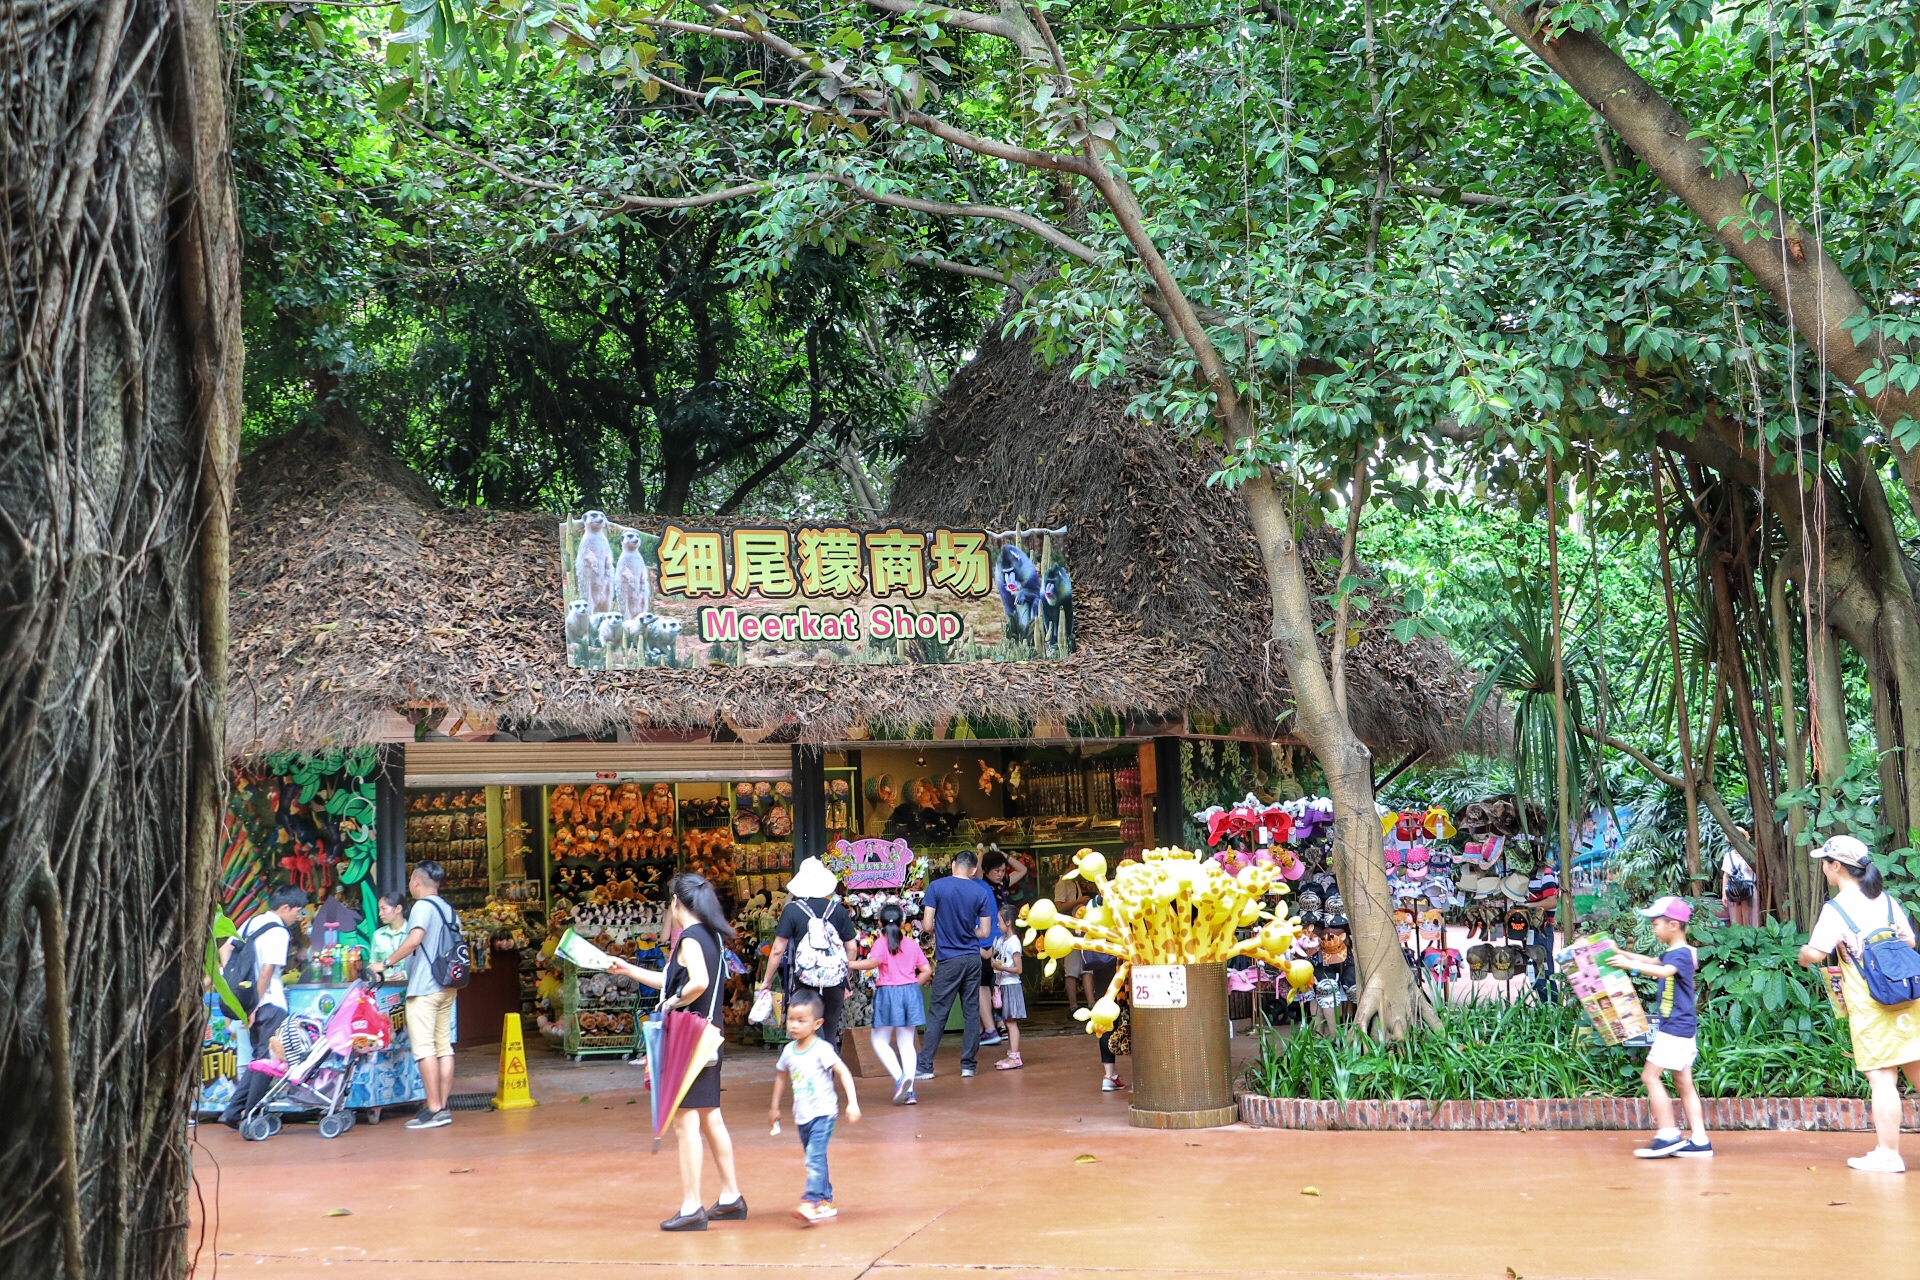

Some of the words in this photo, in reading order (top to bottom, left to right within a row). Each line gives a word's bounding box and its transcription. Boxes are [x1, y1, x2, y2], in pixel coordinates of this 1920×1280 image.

[660, 527, 991, 597] 细尾獴商场
[701, 605, 860, 641] Meerkat
[869, 605, 962, 644] Shop
[1136, 985, 1150, 1000] 25
